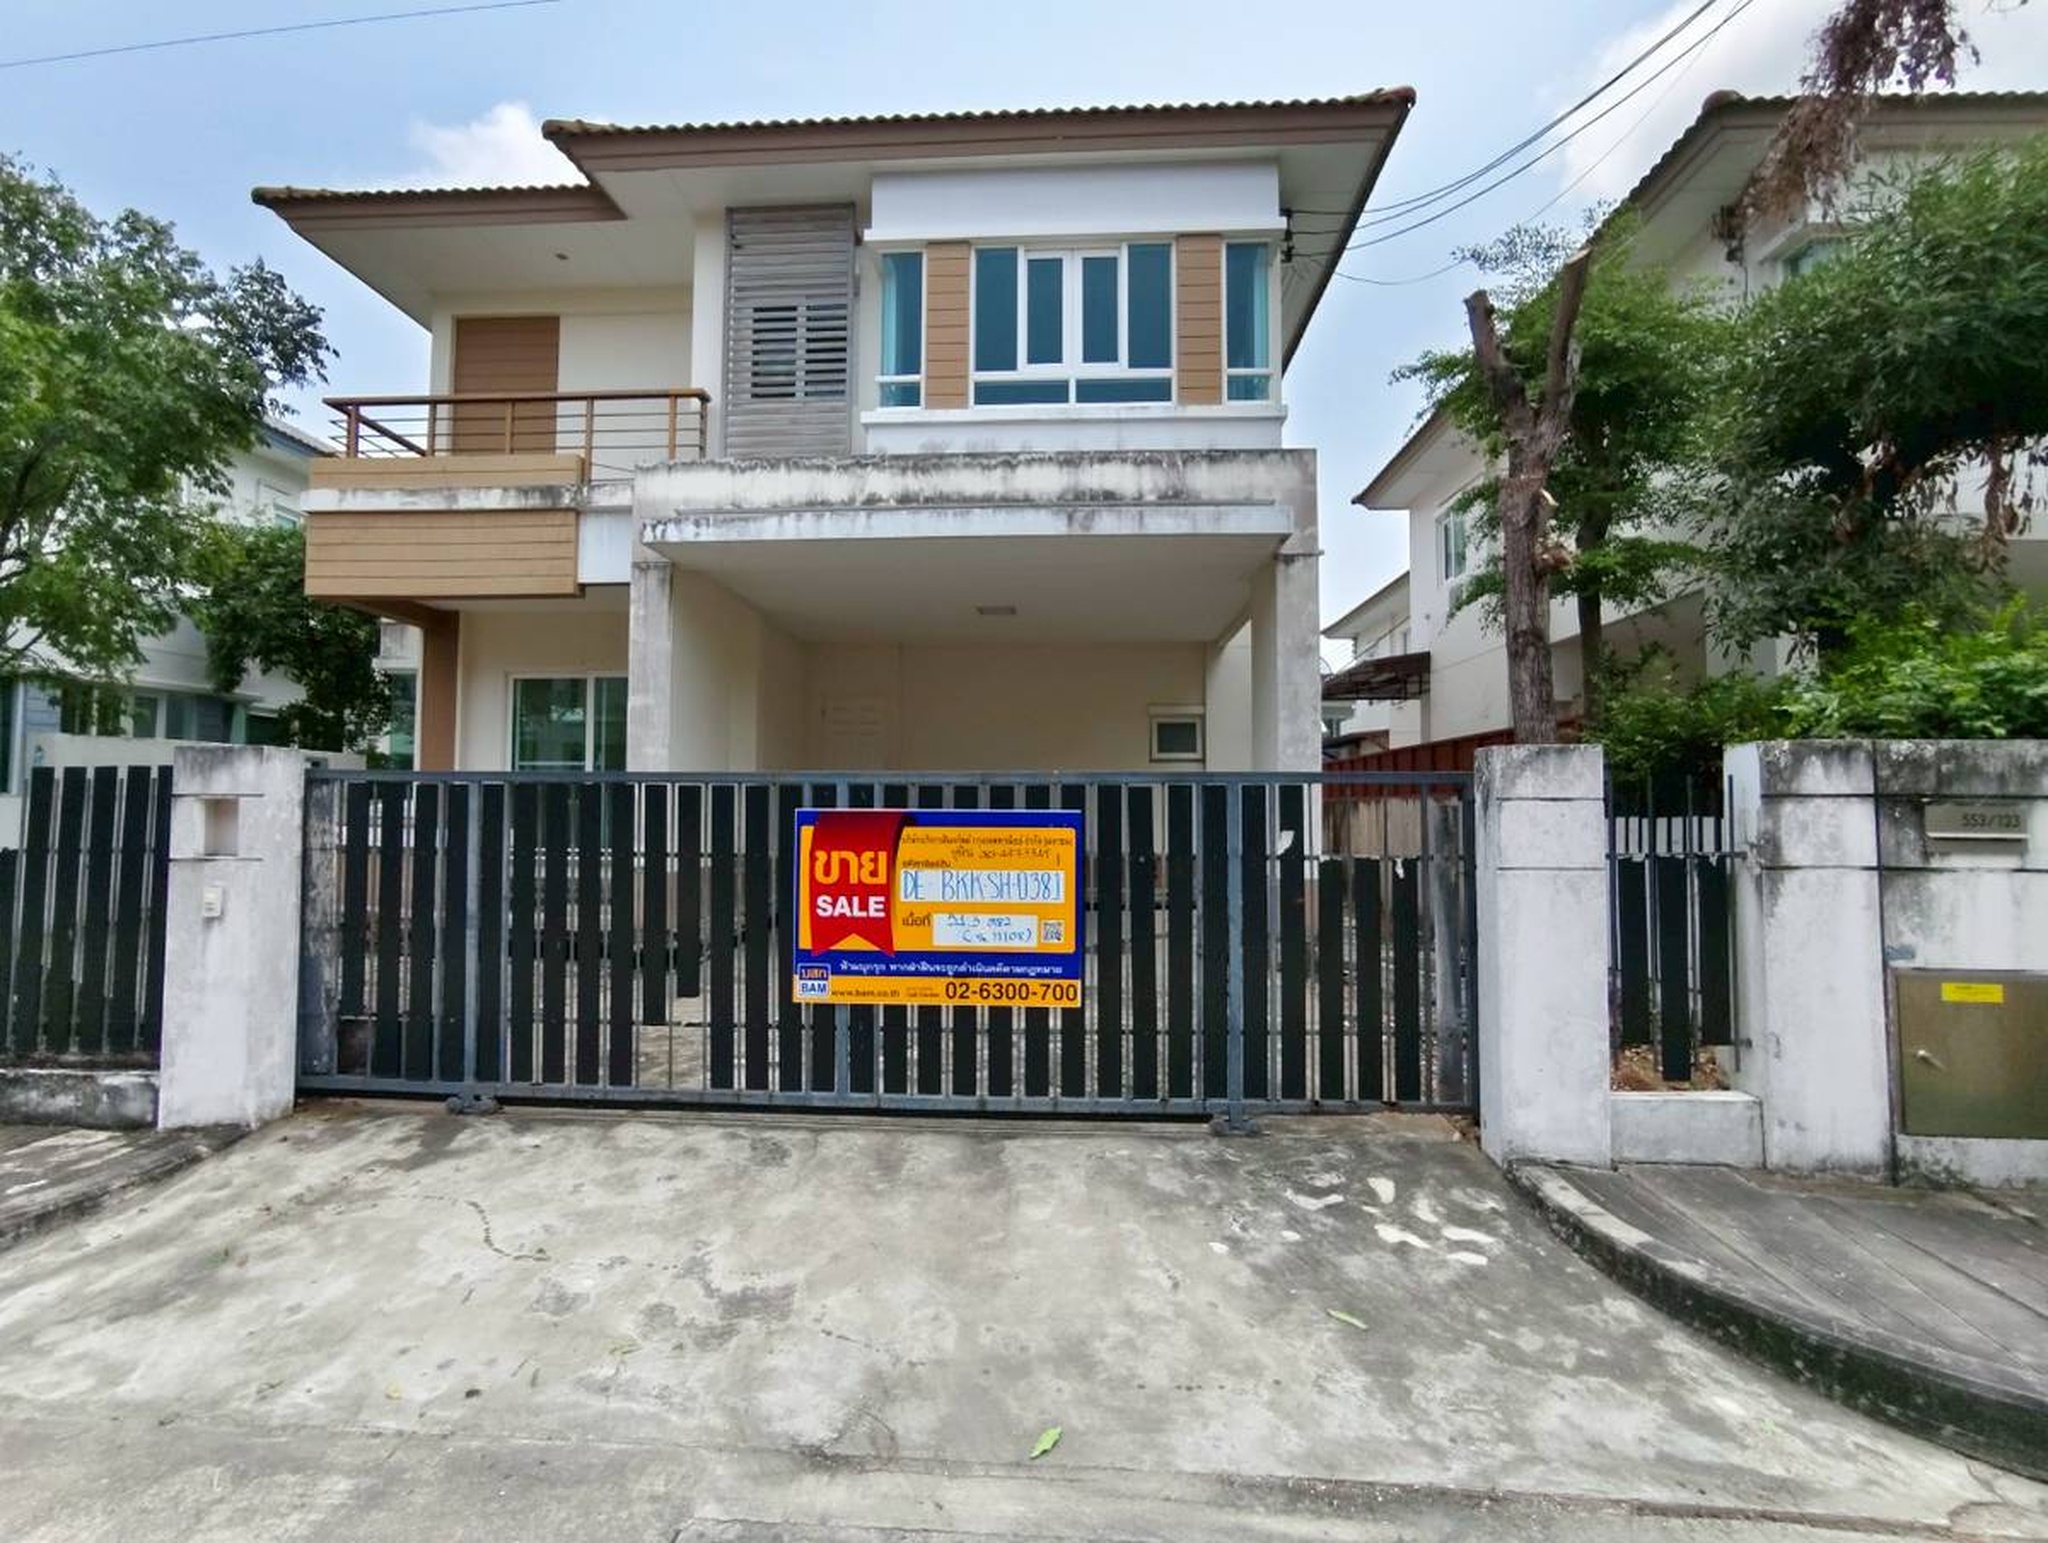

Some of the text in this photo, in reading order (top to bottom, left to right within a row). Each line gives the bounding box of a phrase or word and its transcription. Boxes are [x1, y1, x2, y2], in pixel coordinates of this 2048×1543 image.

[815, 850, 887, 885] ขาย
[816, 896, 886, 917] SALE
[801, 982, 827, 994] BAM
[945, 981, 1078, 1001] 02-6300-700
